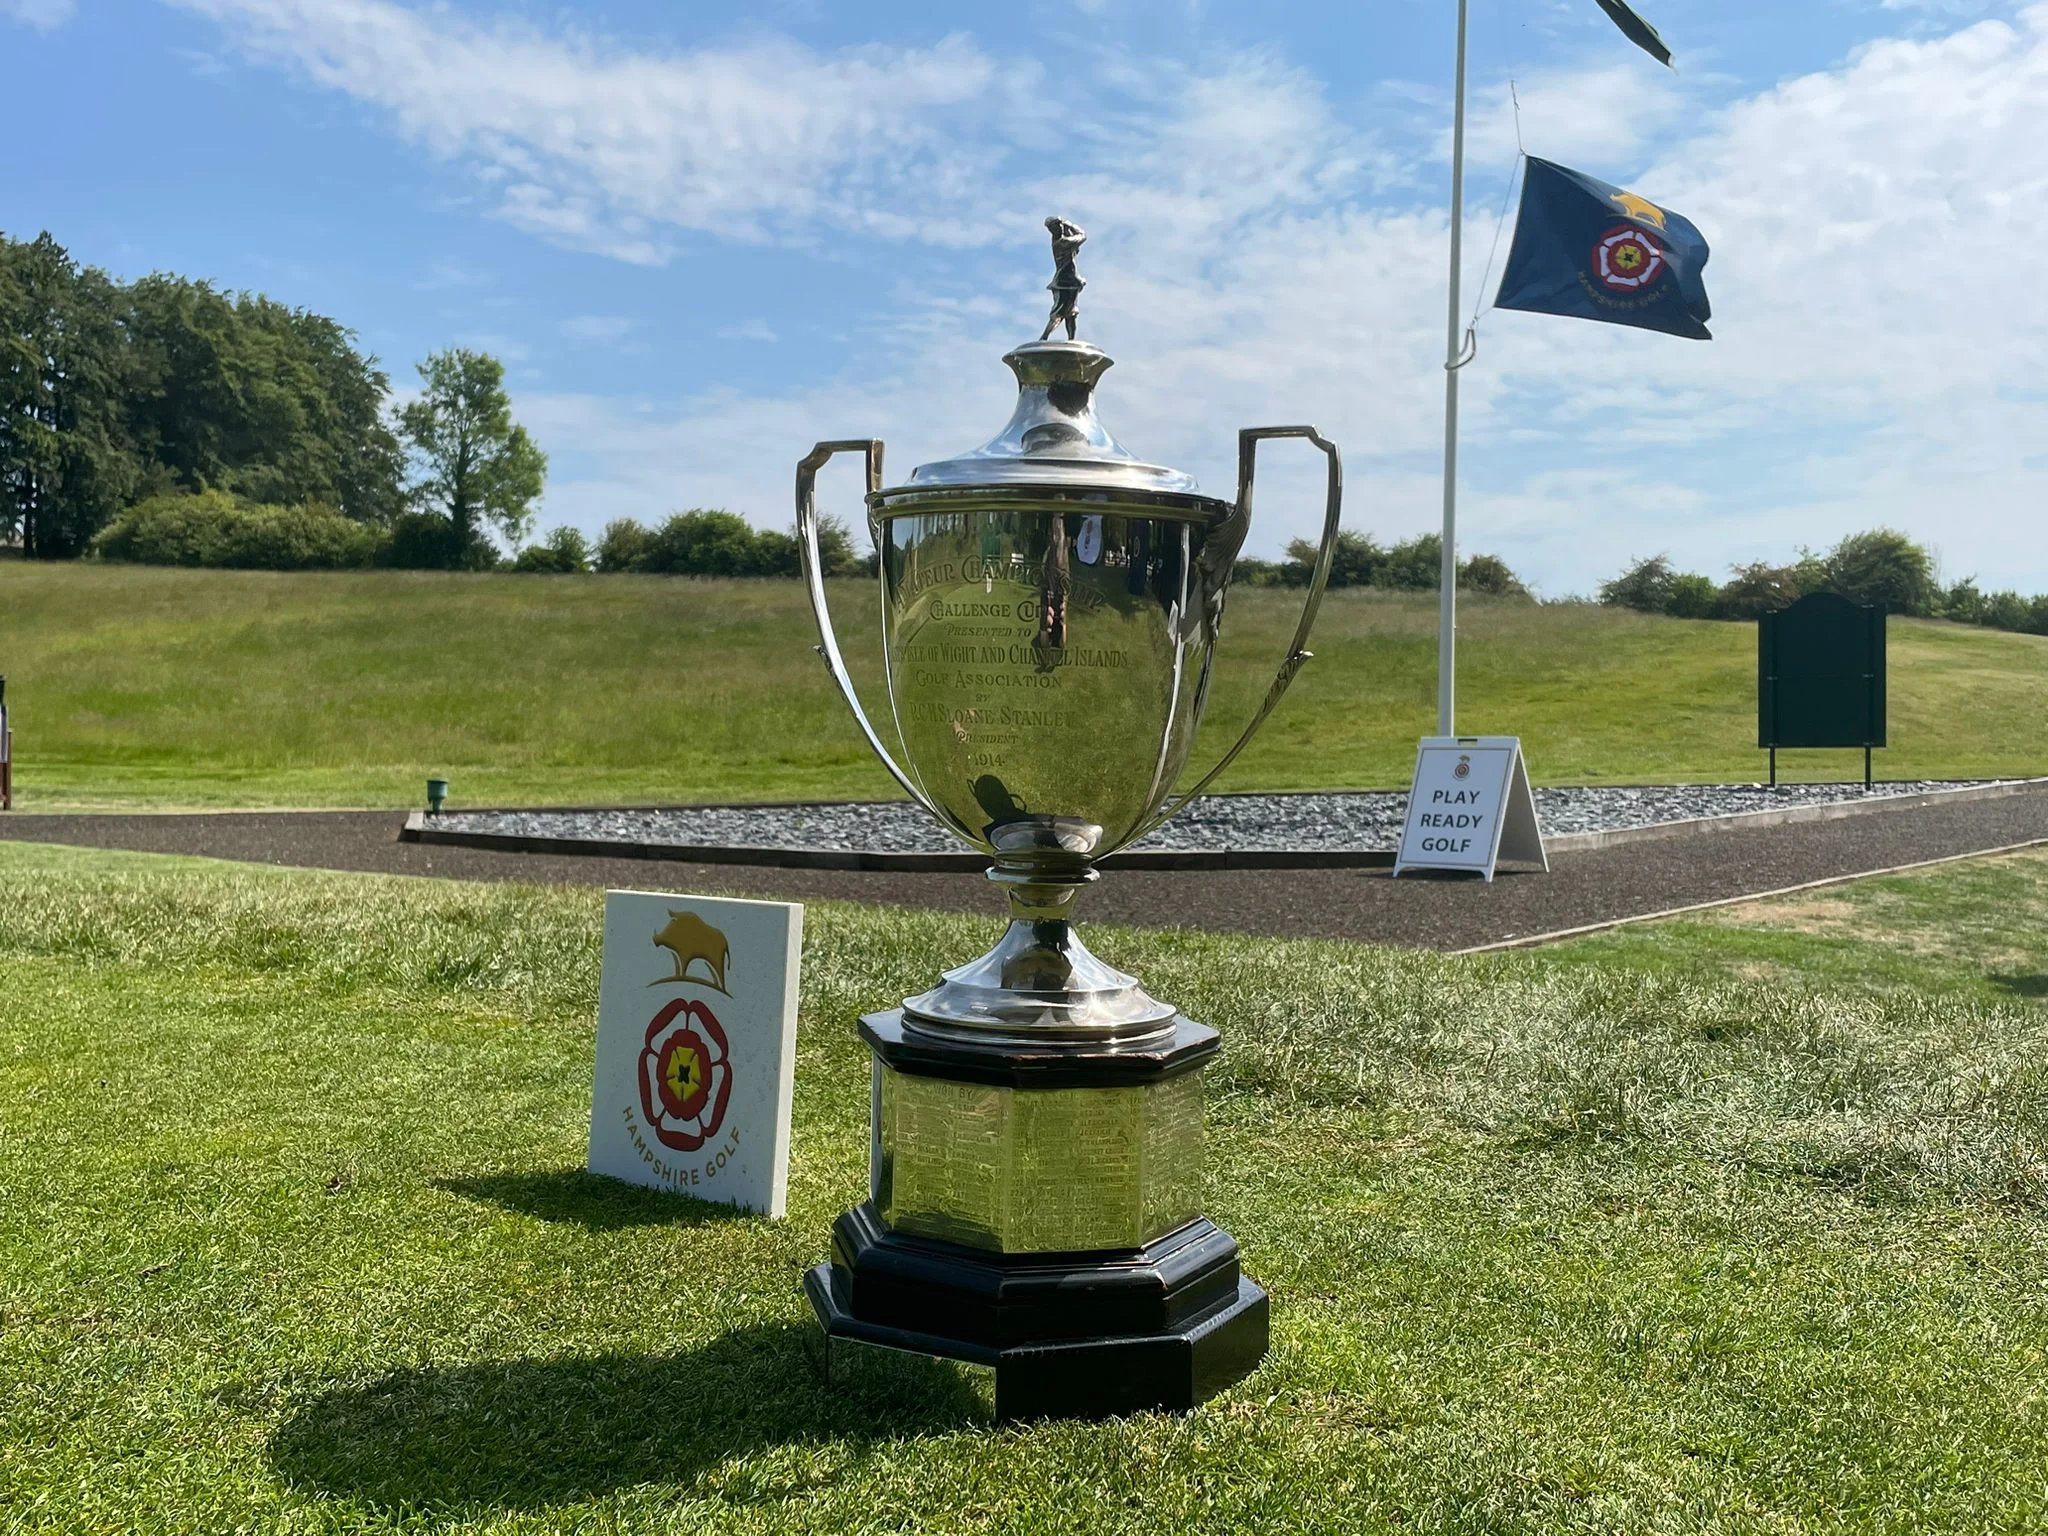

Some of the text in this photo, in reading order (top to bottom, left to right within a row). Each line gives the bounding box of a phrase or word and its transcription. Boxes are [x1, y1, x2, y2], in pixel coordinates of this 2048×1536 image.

[929, 599, 1010, 621] CHALLENGE
[945, 625, 1032, 638] PRESENTED TO
[938, 642, 977, 664] WIGHT
[981, 645, 1005, 665] AND
[1075, 646, 1128, 668] ISLANDS
[915, 669, 1062, 689] GOLF ASSOCIATION
[975, 693, 991, 702] BY
[956, 730, 1020, 744] PRESIDENT
[1432, 790, 1480, 805] PLAY
[1420, 813, 1484, 829] READY
[1421, 837, 1472, 853] GOLF
[622, 1105, 742, 1186] HAMPSHIRE GOLF
